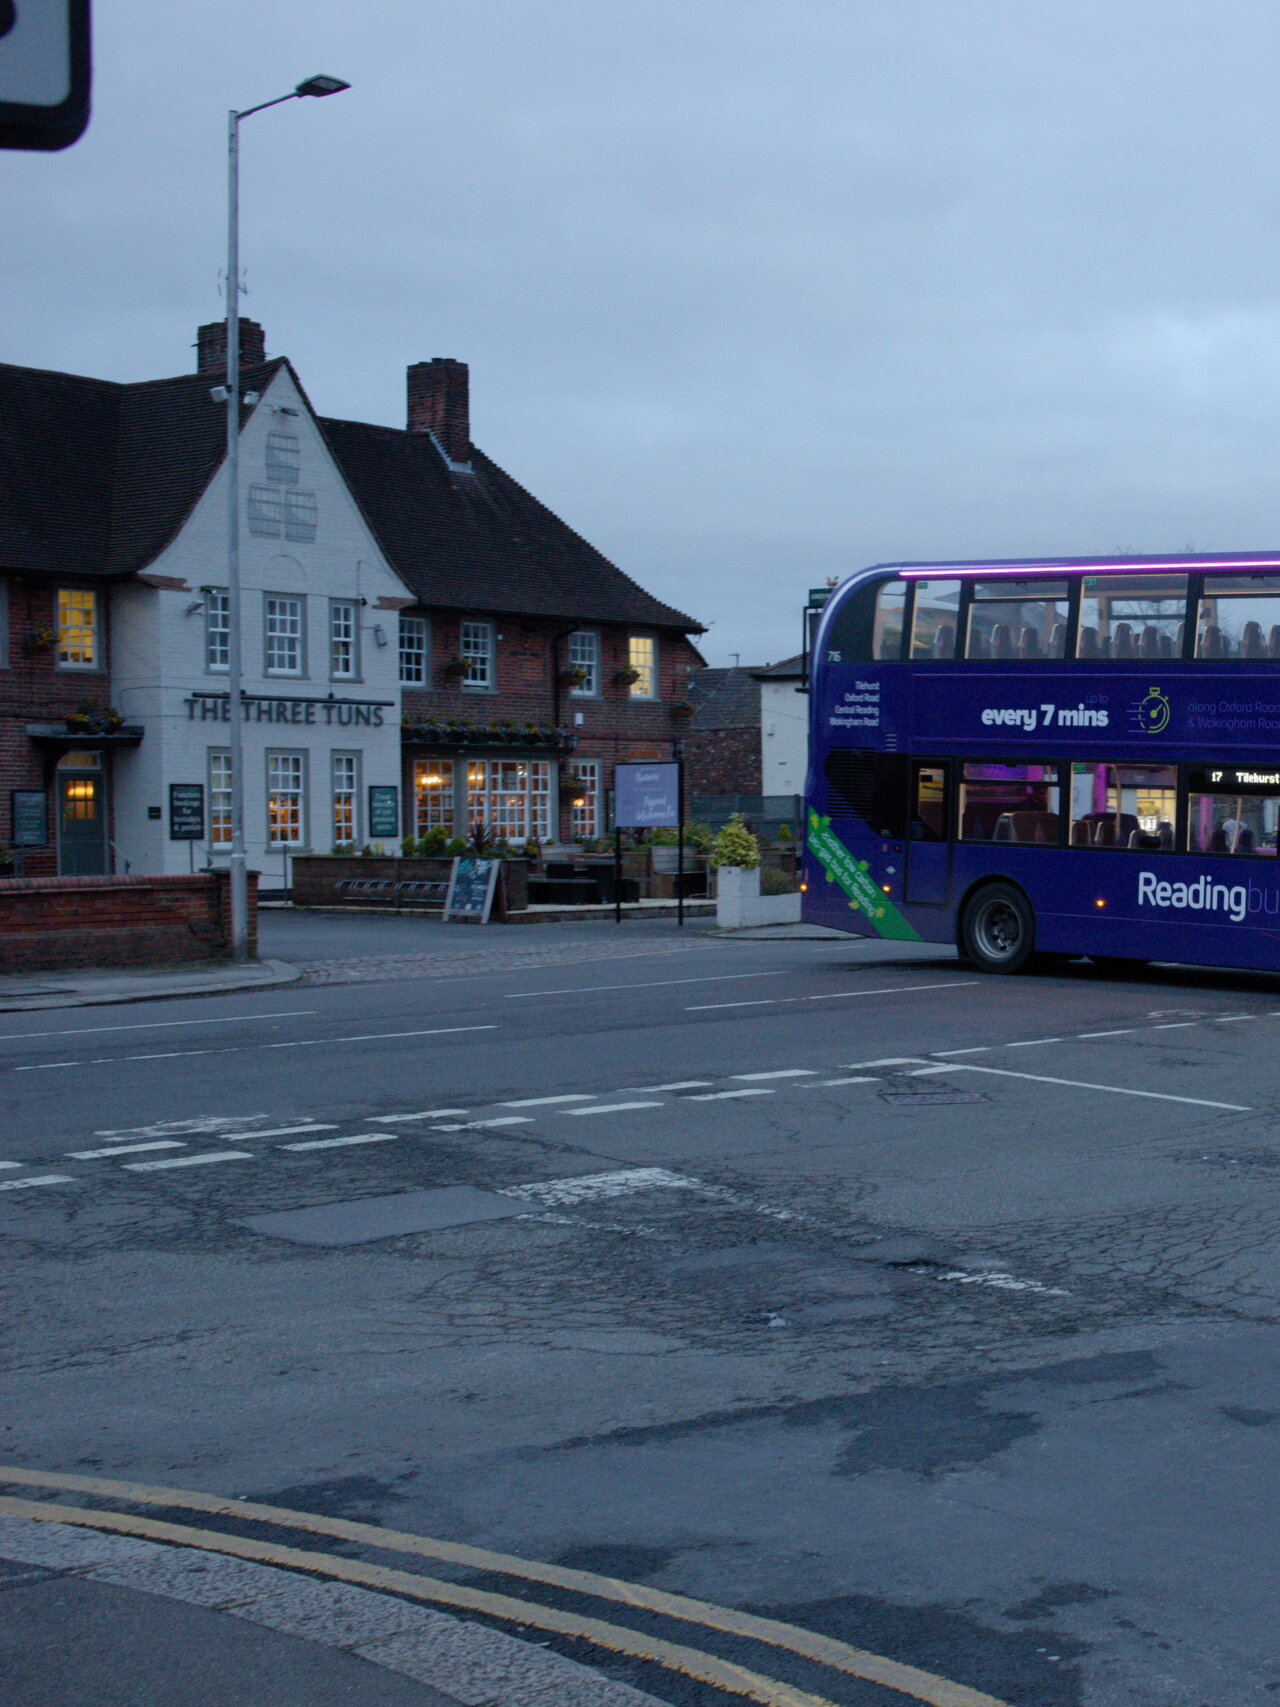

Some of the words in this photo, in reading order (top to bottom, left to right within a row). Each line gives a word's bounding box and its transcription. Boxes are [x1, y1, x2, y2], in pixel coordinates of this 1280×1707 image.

[864, 693, 880, 702] Road
[1085, 695, 1098, 705] up
[1099, 693, 1109, 703] to
[184, 698, 231, 722] THE
[241, 700, 316, 725] THREE
[322, 703, 384, 727] TUNS
[1188, 702, 1216, 715] along
[1219, 701, 1252, 713] Oxford
[981, 708, 1037, 732] every
[1040, 705, 1055, 726] 7
[1058, 703, 1110, 728] mins
[1188, 718, 1195, 728] &
[1198, 717, 1256, 730] Wokingham
[1211, 771, 1223, 782] 17
[1236, 772, 1280, 785] Tilehurst
